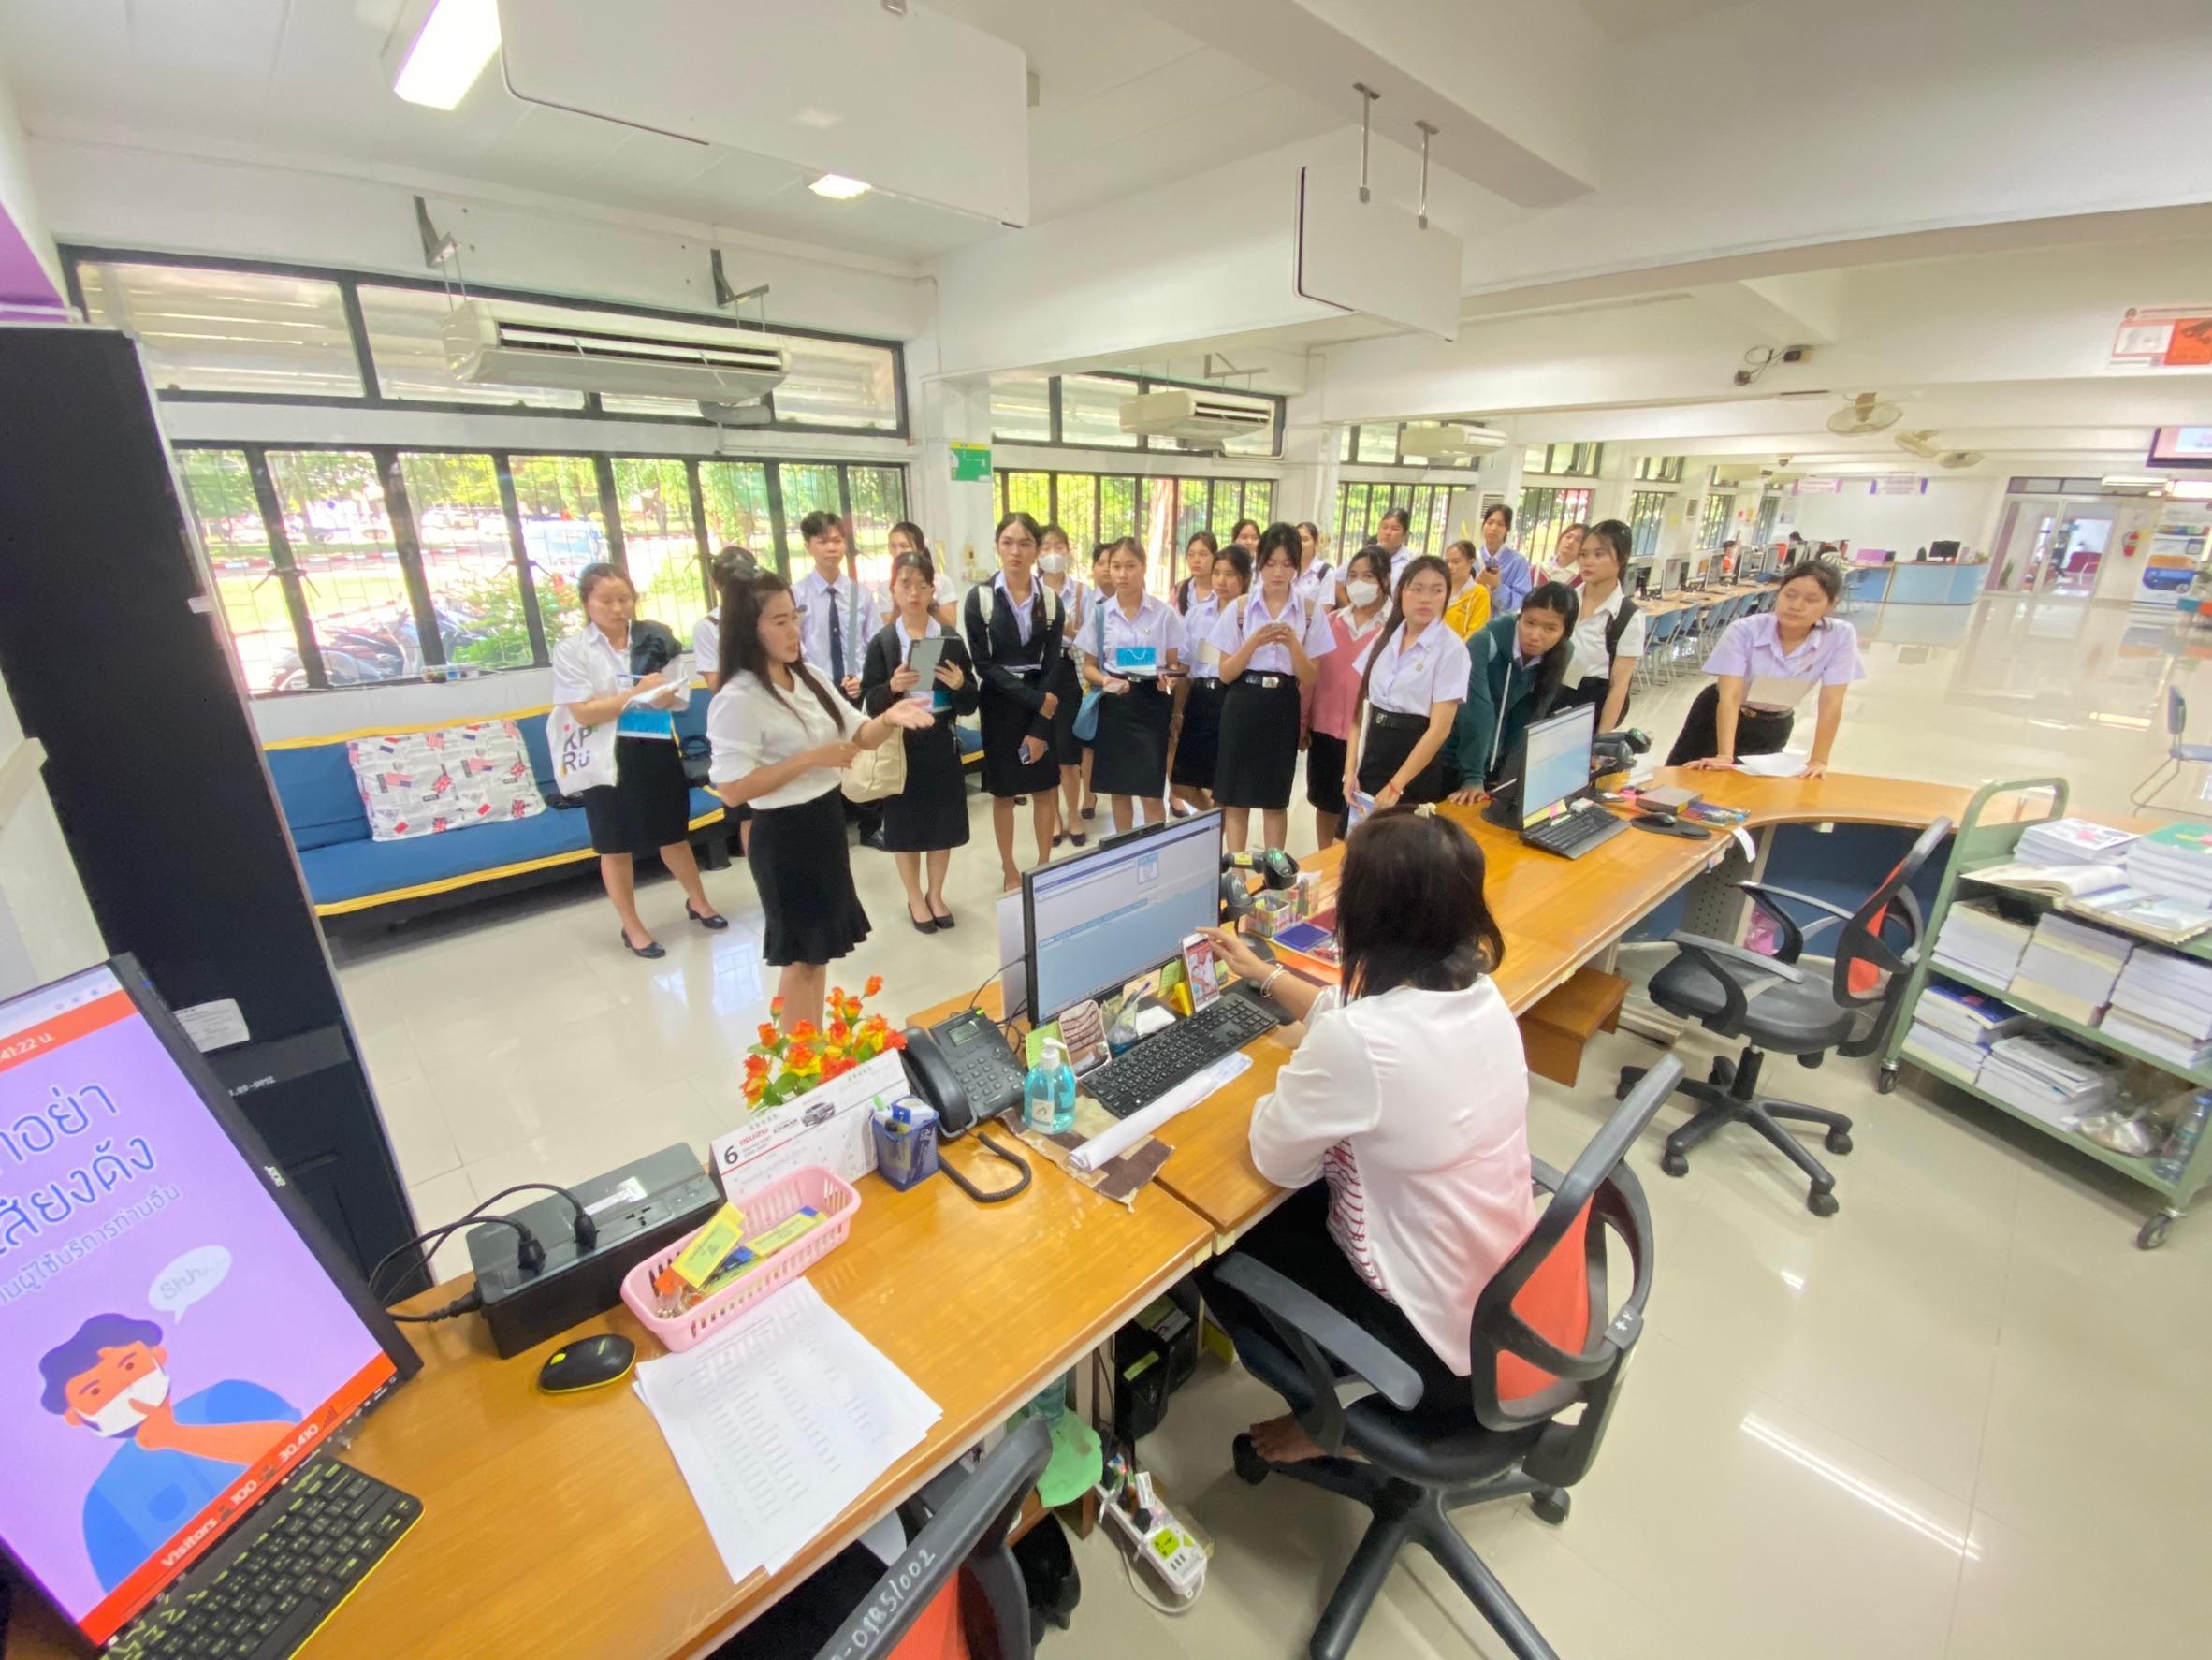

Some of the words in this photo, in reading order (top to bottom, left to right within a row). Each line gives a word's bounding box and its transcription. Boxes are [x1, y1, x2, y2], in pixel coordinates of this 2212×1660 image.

[739, 1128, 769, 1146] ISUZU
[723, 1144, 739, 1165] 6
[161, 1518, 218, 1567] Visitors
[230, 1479, 257, 1506] 100
